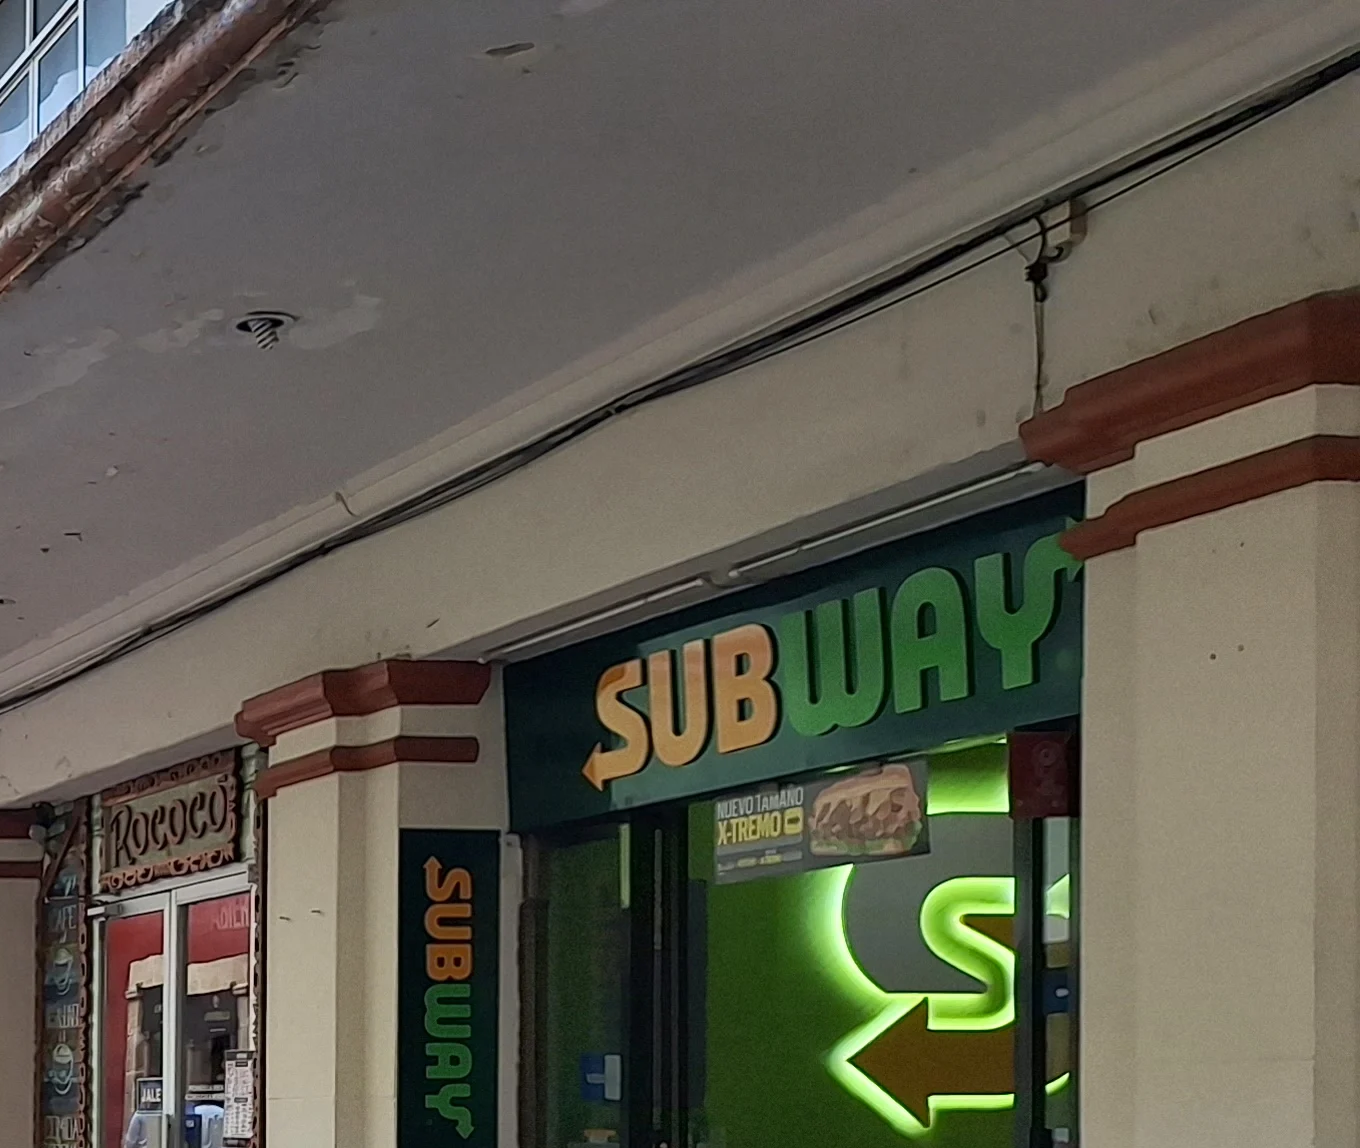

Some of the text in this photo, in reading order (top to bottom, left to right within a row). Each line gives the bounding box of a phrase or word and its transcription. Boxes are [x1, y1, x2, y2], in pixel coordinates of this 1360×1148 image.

[581, 517, 1085, 791] SUBWAY
[717, 795, 754, 819] NUEVO
[717, 810, 782, 846] X-TREMO
[422, 855, 475, 1141] SUBWAY
[140, 1087, 162, 1103] JALE
